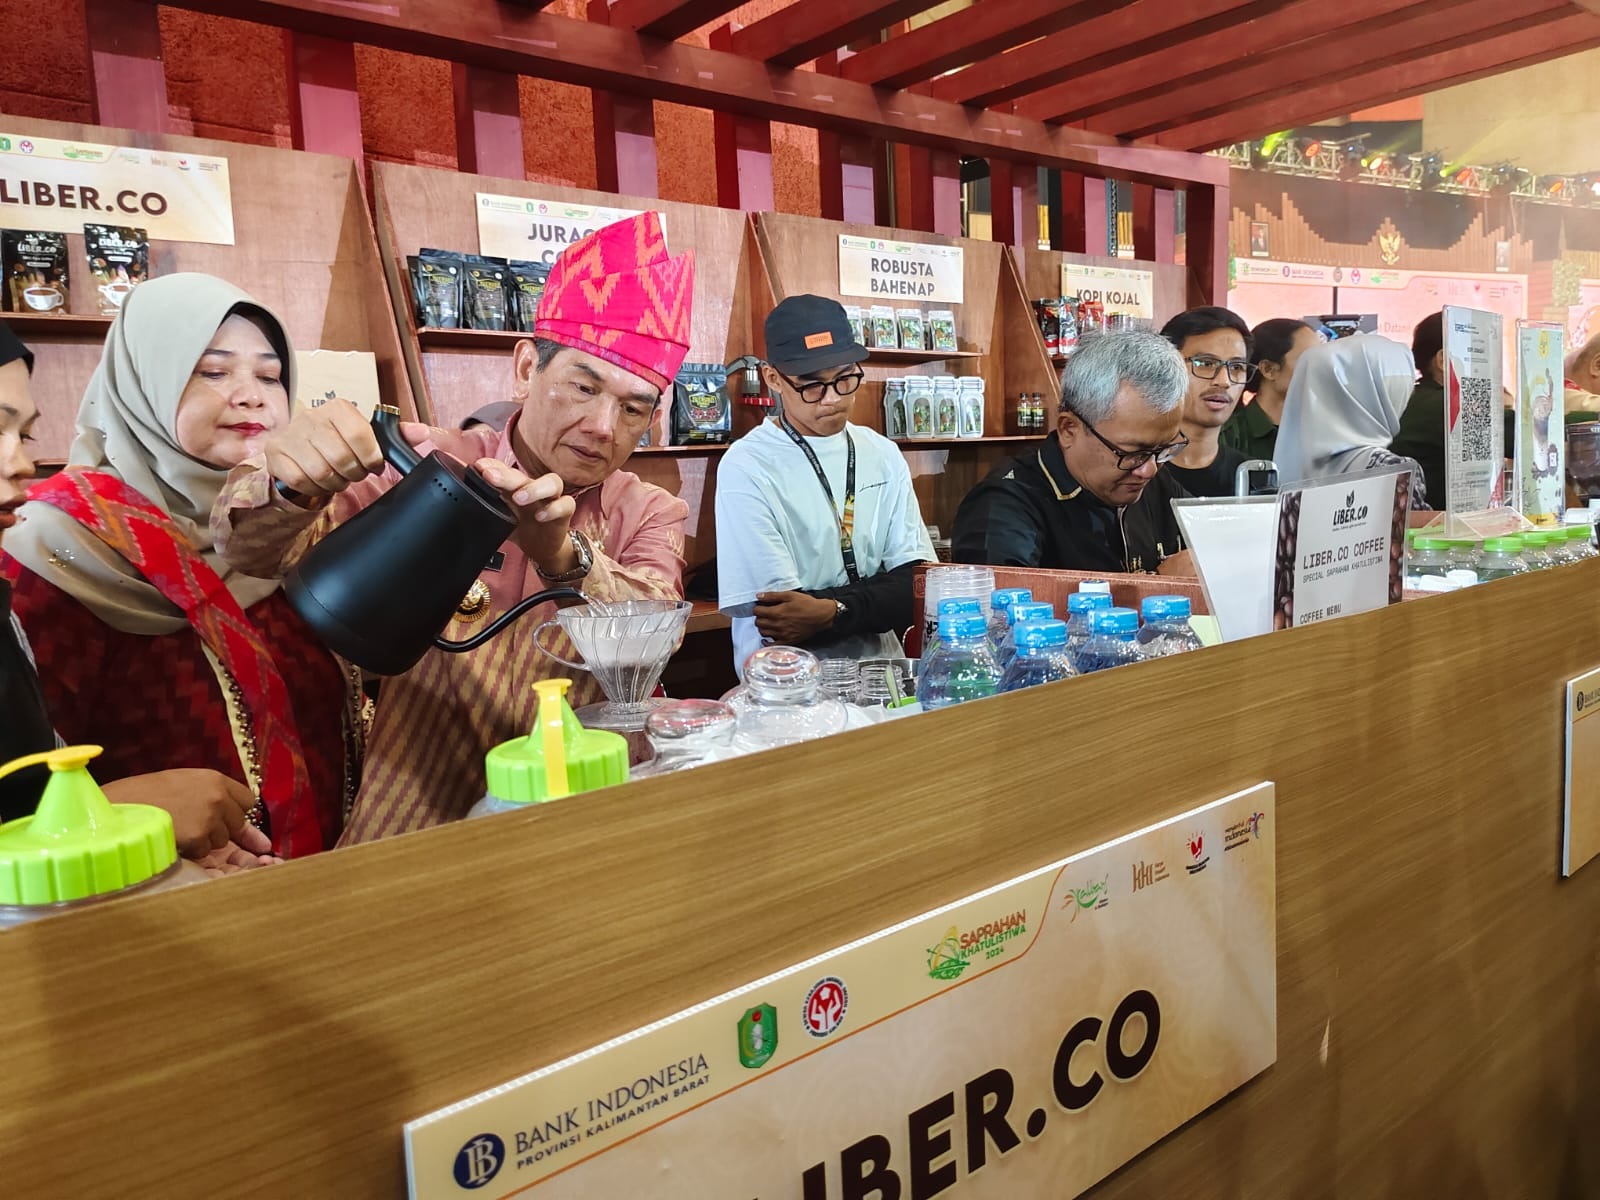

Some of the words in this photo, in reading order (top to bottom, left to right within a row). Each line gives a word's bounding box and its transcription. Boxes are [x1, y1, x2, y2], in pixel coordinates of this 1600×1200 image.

[0, 179, 168, 216] LIBER.CO
[871, 258, 934, 277] ROBUSTA
[871, 278, 935, 296] BAHENAP
[1077, 289, 1102, 303] KOPI
[1106, 291, 1140, 305] KOJAL
[1303, 546, 1349, 569] LIBER.CO
[1354, 537, 1384, 557] COFFEE
[1303, 572, 1324, 584] SPECIAL
[1300, 609, 1323, 624] COFFEE
[1327, 603, 1341, 617] MENU
[960, 908, 1026, 949] SAPRAHAN
[960, 924, 1026, 959] KHATULISTIWA
[514, 1107, 580, 1154] BANK
[588, 1053, 709, 1122] INDONESIA
[753, 989, 1161, 1200] BER.CO
[517, 1135, 582, 1170] PROVINSI
[586, 1093, 669, 1138] KALIMANTAN
[674, 1074, 711, 1097] BARAT
